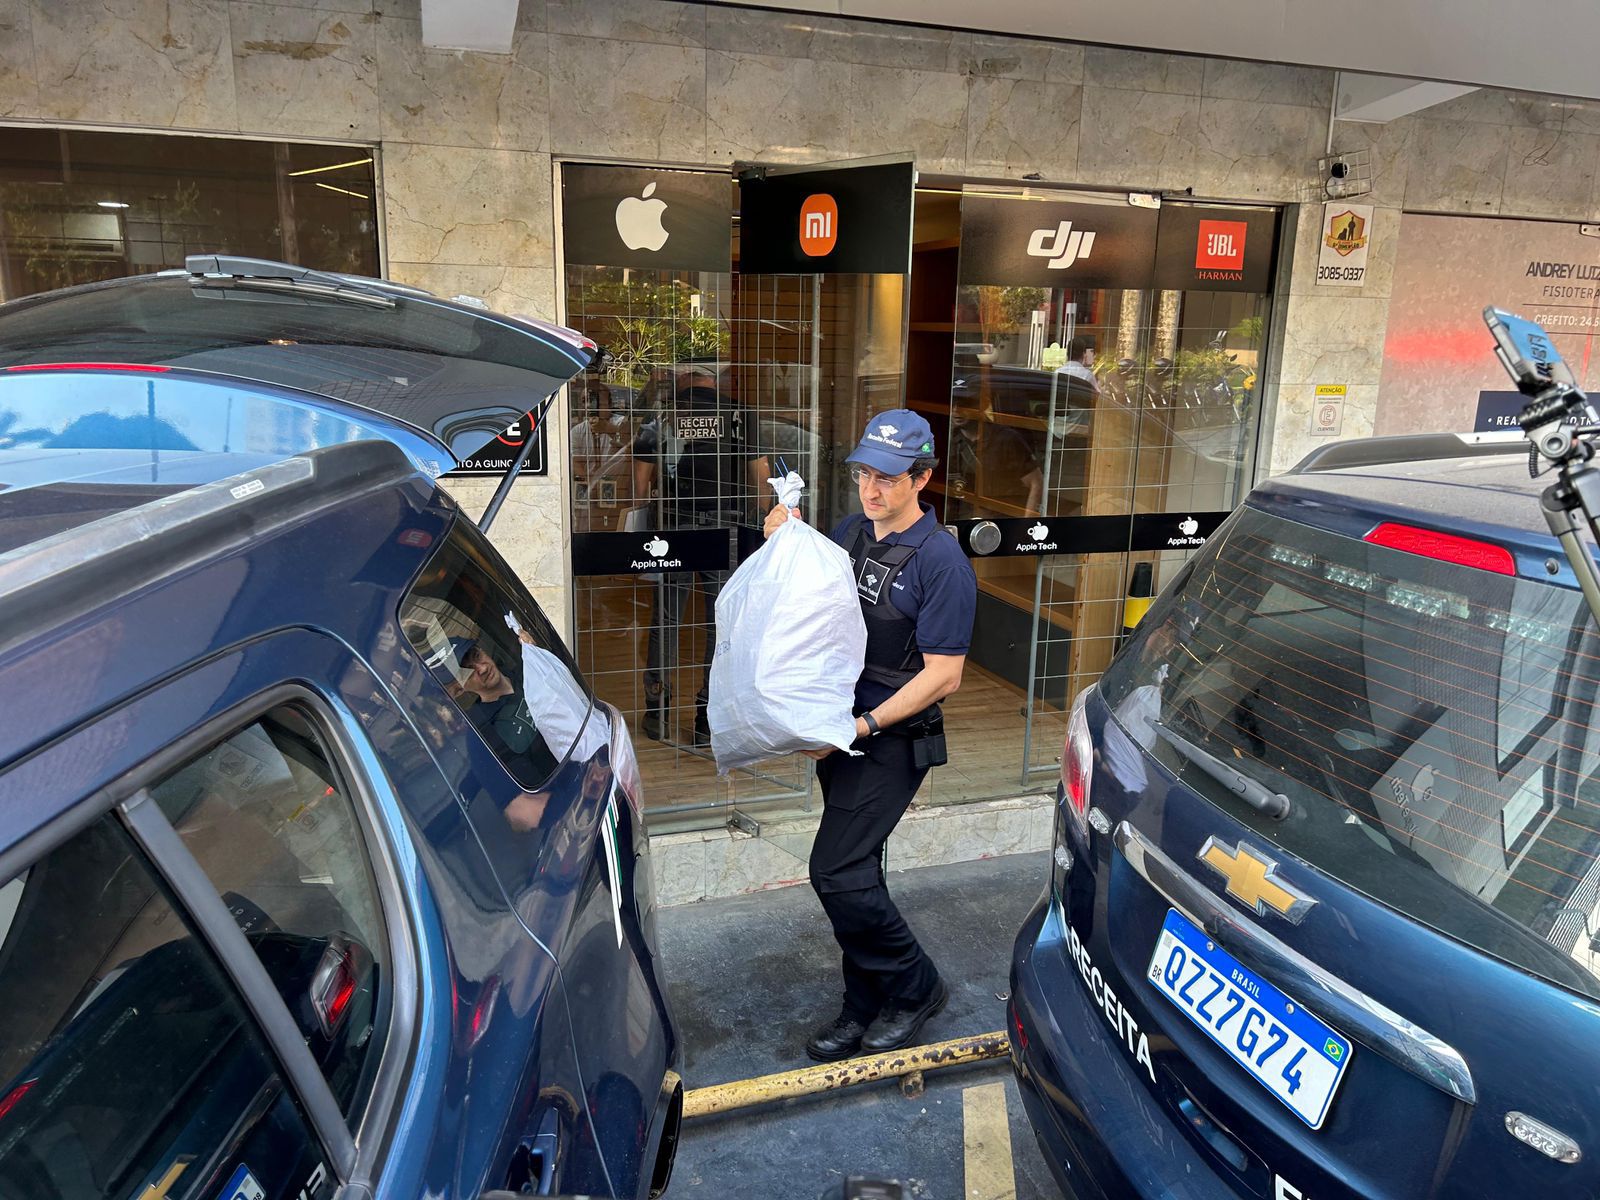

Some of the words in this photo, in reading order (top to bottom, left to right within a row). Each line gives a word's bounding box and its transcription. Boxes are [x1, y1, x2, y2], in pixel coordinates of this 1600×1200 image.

[1199, 270, 1243, 281] HARMAN
[1318, 265, 1365, 281] 3085-0337
[1525, 261, 1576, 279] ANDREY
[1534, 314, 1578, 326] CREFITO:
[1319, 386, 1342, 394] ATENÇÃO
[680, 418, 719, 428] RECEITA
[457, 459, 474, 468] ITO
[474, 459, 484, 468] A
[483, 459, 531, 469] GUINCO!
[1188, 536, 1206, 545] Tech
[1016, 543, 1038, 552] Apple
[1038, 541, 1057, 550] Tech
[631, 560, 657, 569] Apple
[657, 558, 681, 568] Tech
[1230, 968, 1261, 999] BRASIL
[1070, 925, 1157, 1084] RECEITA
[1151, 964, 1163, 982] BR
[1163, 945, 1308, 1096] QZZ7G74
